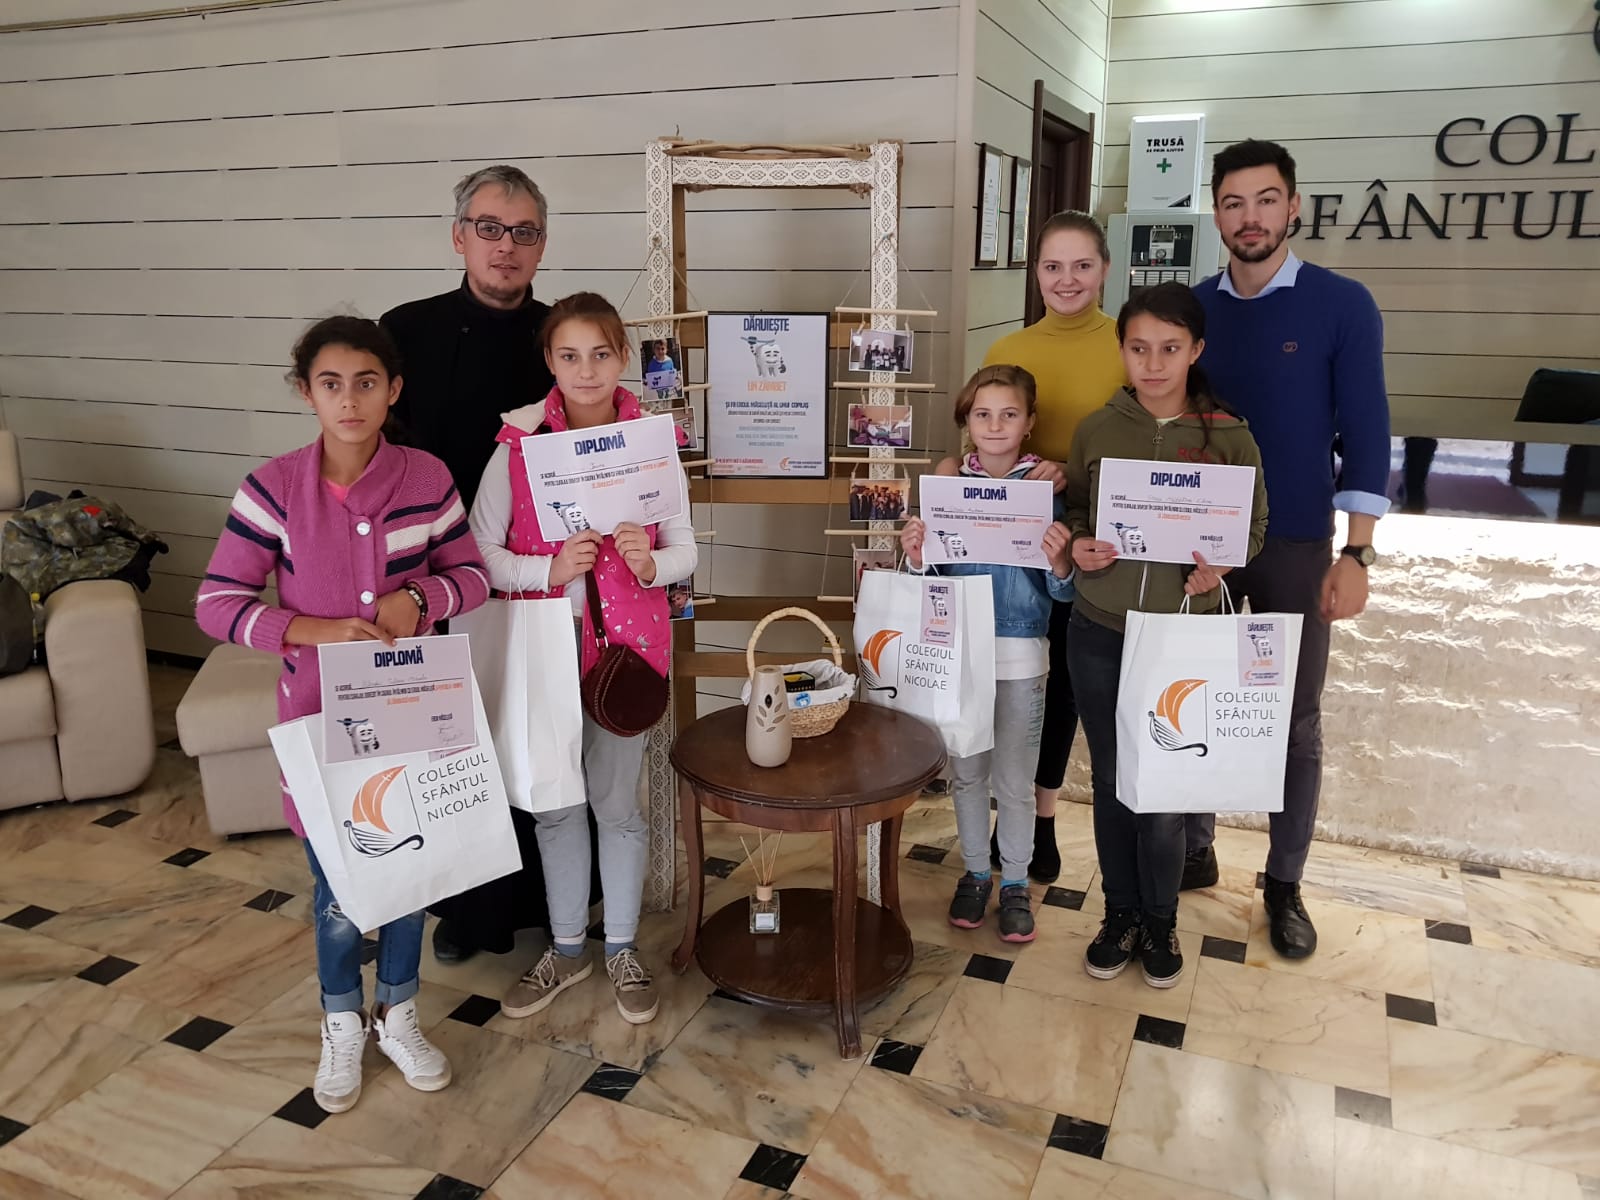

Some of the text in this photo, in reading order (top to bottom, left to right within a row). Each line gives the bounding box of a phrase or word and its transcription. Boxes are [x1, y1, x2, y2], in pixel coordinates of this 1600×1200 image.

[1146, 135, 1184, 147] TRUSĂ
[1288, 178, 1600, 240] FÂNTUL
[743, 314, 790, 335] DĂRUIEȘTE
[574, 430, 626, 456] DIPLOMĂ
[1150, 471, 1201, 488] DIPLOMĂ
[963, 486, 1007, 501] DIPLOMĂ
[374, 645, 424, 668] DIPLOMĂ
[906, 644, 955, 660] COLEGIUL
[905, 658, 950, 675] SFÂNTUL
[904, 674, 947, 690] NICOLAE
[1215, 692, 1281, 703] COLEGIUL
[1215, 707, 1277, 720] SFÂNTUL
[1216, 726, 1273, 738] NICOLAE
[418, 752, 489, 785] COLEGIUL
[422, 772, 489, 804] SFÂNTUL
[427, 790, 489, 822] NICOLAE
